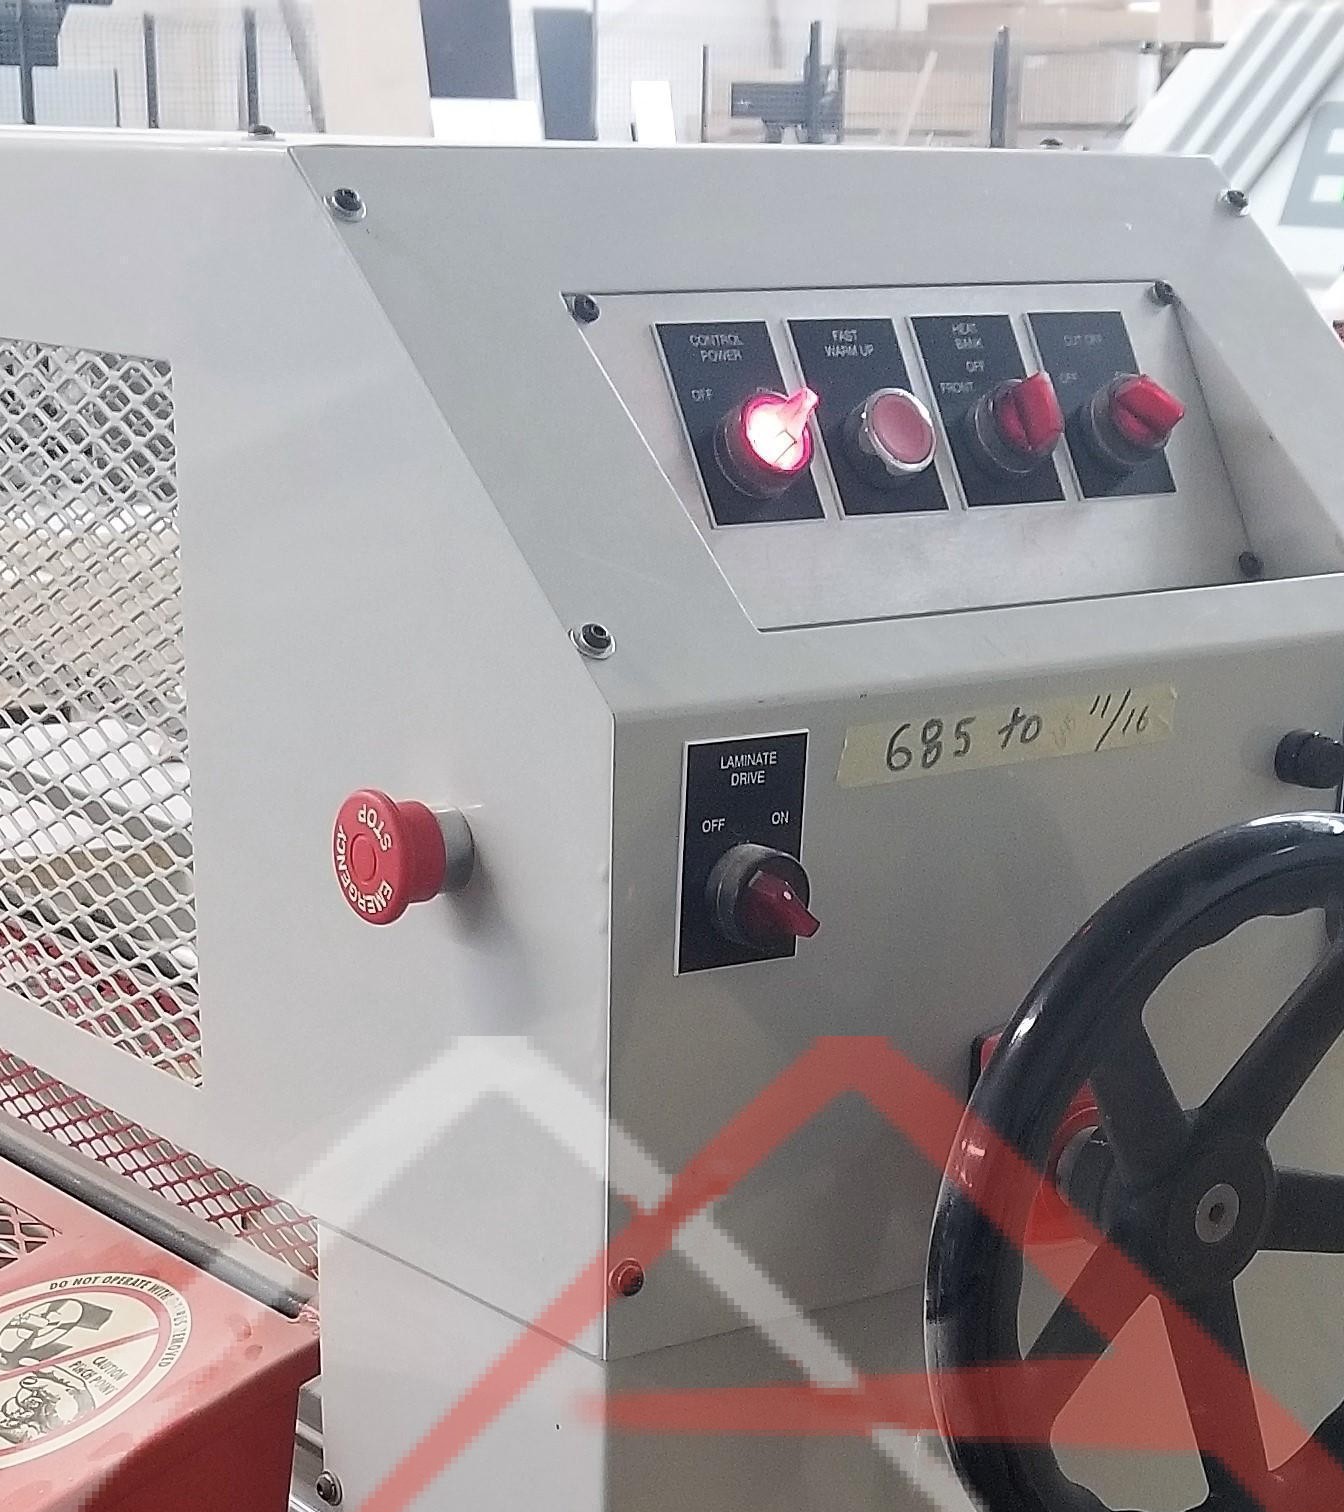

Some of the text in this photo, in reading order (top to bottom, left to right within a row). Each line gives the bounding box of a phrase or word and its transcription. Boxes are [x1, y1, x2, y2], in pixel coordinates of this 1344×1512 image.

[688, 334, 745, 347] CONTROL
[830, 329, 858, 342] FAST
[700, 349, 743, 363] POWER
[859, 344, 874, 357] UP
[691, 388, 713, 401] OFF
[939, 381, 974, 395] FRONT
[885, 716, 976, 772] 685
[997, 706, 1042, 751] to
[720, 751, 777, 770] LAMINATE
[731, 770, 765, 787] DRIVE
[702, 818, 726, 833] OFF
[771, 811, 789, 825] ON
[357, 803, 393, 852] STOP
[336, 824, 394, 914] EMERGENCY
[49, 1281, 68, 1290] DO
[72, 1276, 101, 1286] NOT
[102, 1275, 151, 1290] OPERATE
[68, 1360, 96, 1382] PINCH
[92, 1356, 129, 1382] CAUTION
